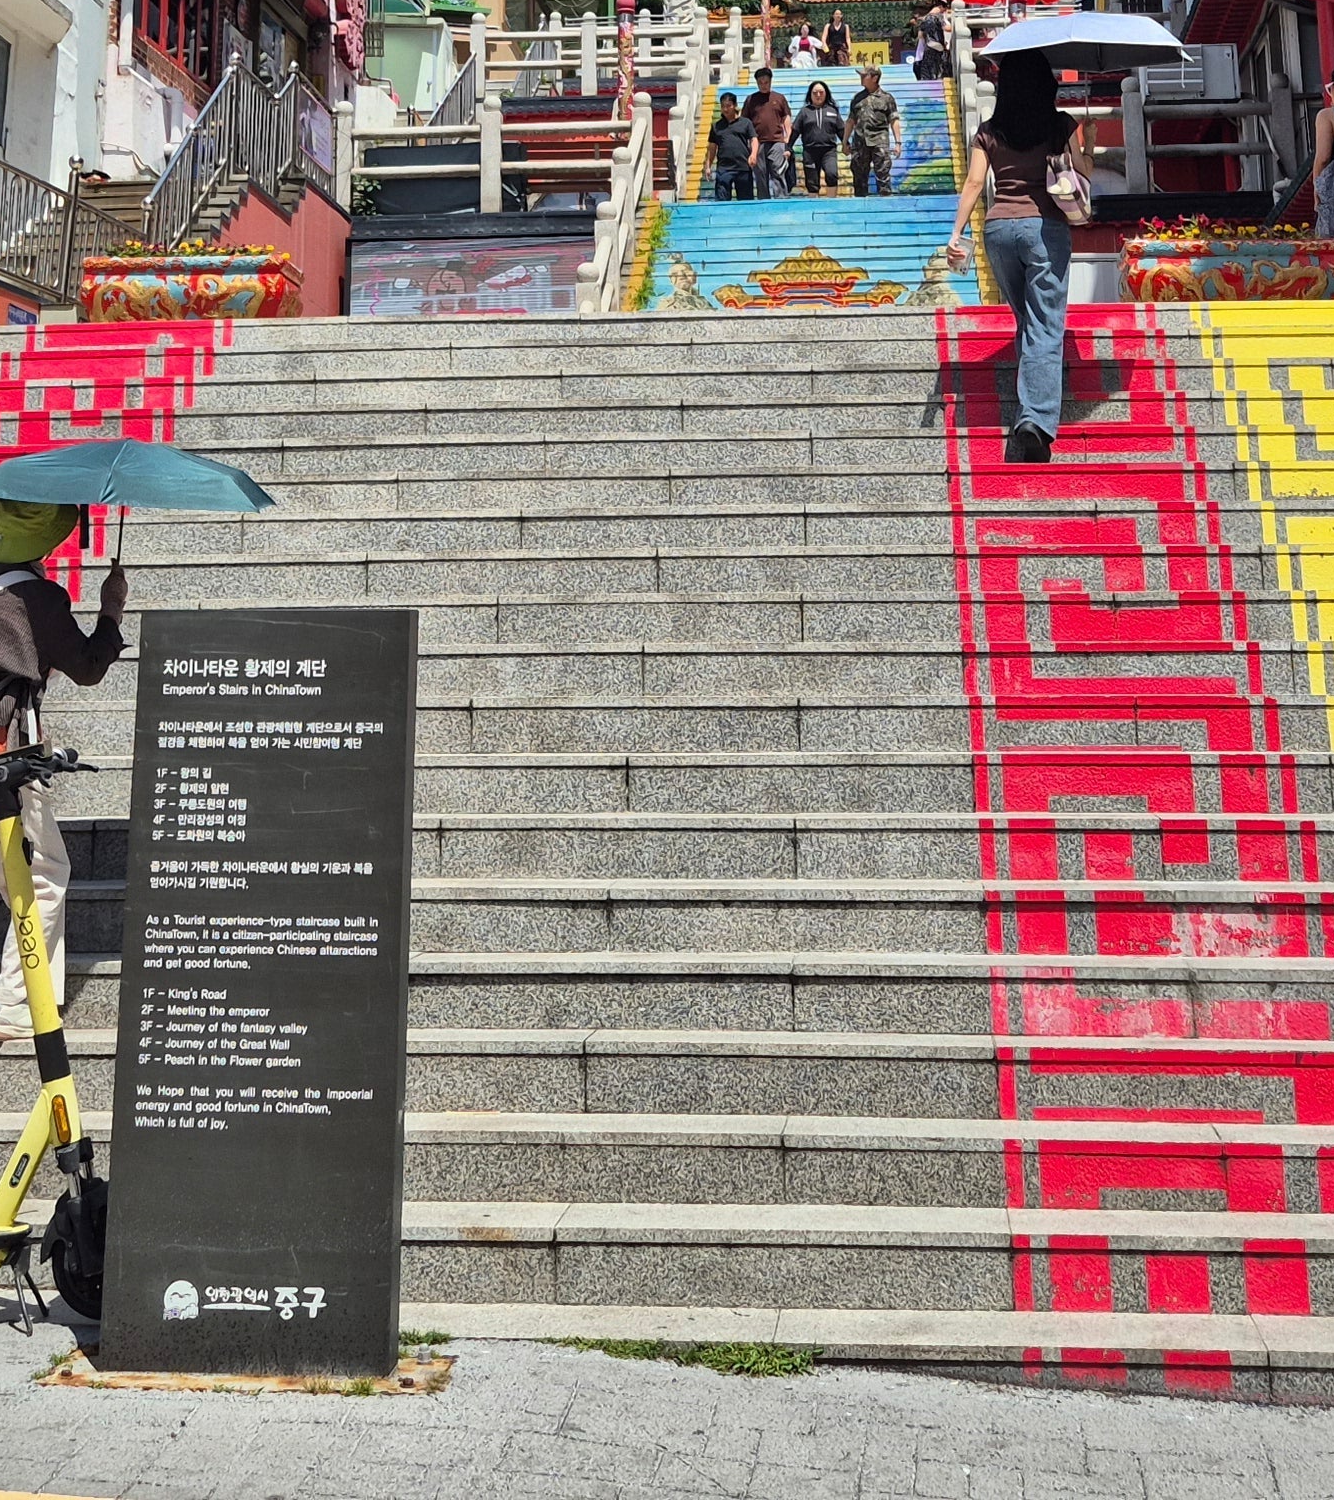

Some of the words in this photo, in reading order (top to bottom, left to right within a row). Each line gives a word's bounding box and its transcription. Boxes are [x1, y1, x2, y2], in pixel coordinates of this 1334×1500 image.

[163, 659, 239, 677] 차이나타운
[244, 659, 290, 677] 황제의
[296, 659, 327, 677] 계단
[163, 682, 215, 696] Emperor's
[219, 684, 248, 695] Stairs
[252, 684, 261, 695] in
[265, 684, 321, 695] ChinaTown
[146, 915, 159, 925] As
[163, 917, 169, 925] a
[174, 915, 205, 925] Tourist
[209, 915, 292, 927] experience-type
[296, 916, 340, 927] staircase
[344, 917, 365, 927] built
[370, 917, 378, 927] in
[17, 912, 39, 969] deer
[145, 928, 199, 940] ChinaTown,
[203, 929, 208, 939] it
[212, 929, 220, 939] is
[223, 931, 229, 939] a
[232, 929, 331, 942] citizen-participating
[334, 931, 378, 941] staircase
[145, 943, 174, 953] where
[177, 946, 194, 955] you
[219, 944, 274, 955] experience
[277, 944, 316, 955] Chinese
[143, 958, 162, 968] and
[166, 958, 182, 969] get
[185, 958, 210, 969] good
[213, 958, 250, 969] fortune.
[137, 1085, 151, 1095] We
[158, 1085, 184, 1097] Hope
[190, 1086, 209, 1096] that
[216, 1089, 233, 1098] you
[240, 1087, 255, 1097] will
[262, 1087, 298, 1098] receive
[305, 1088, 320, 1098] the
[274, 1287, 327, 1320] 중구
